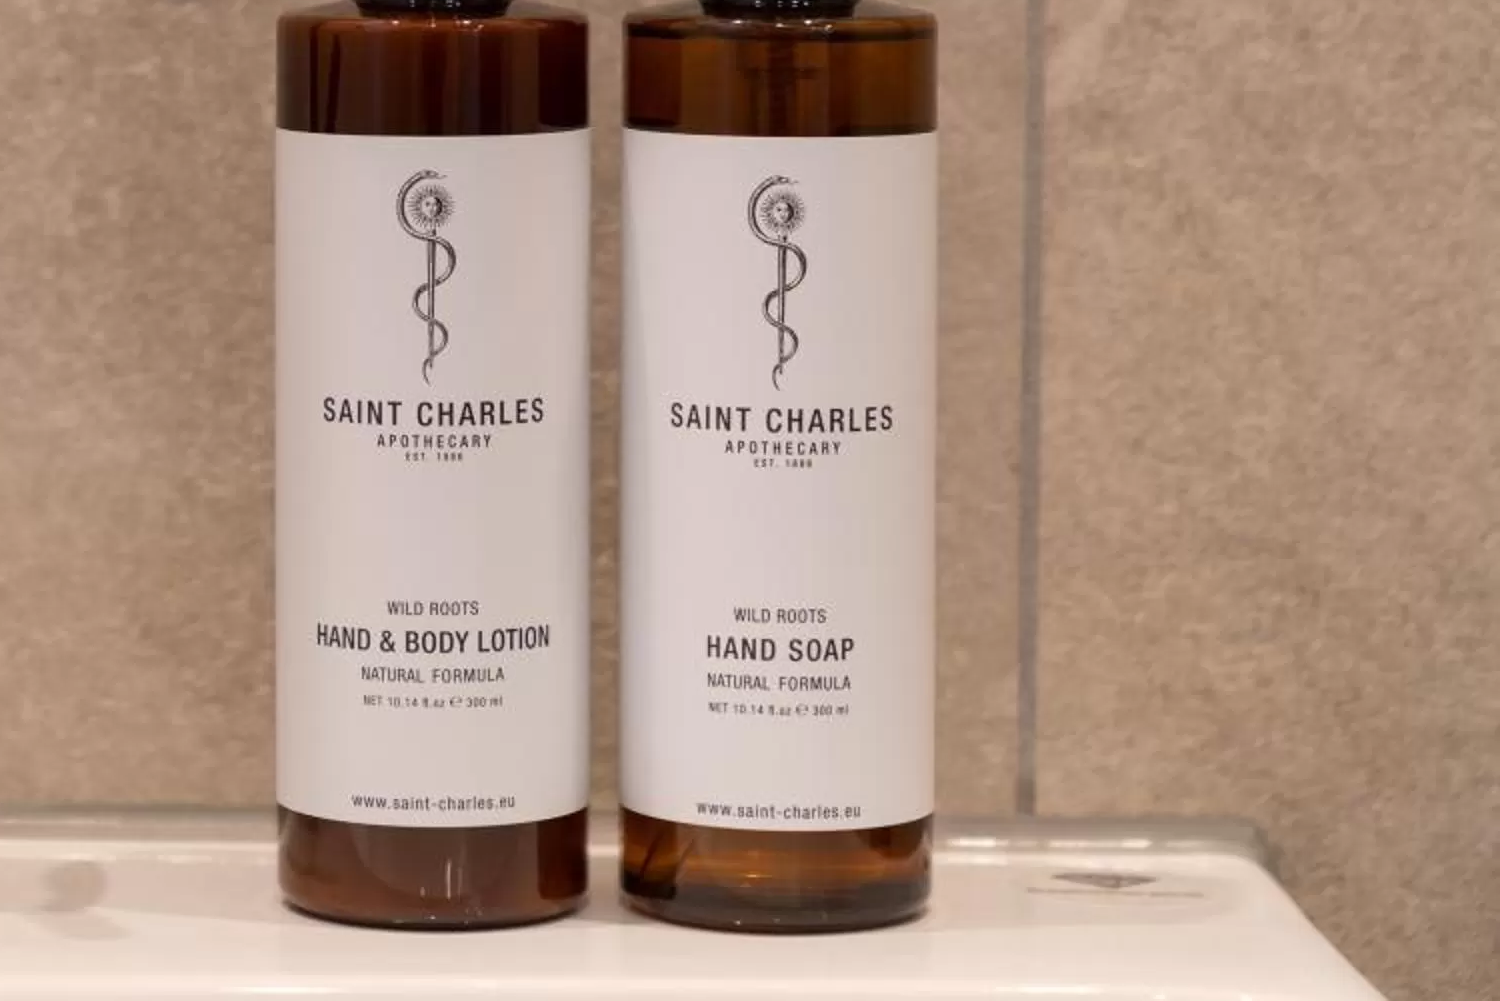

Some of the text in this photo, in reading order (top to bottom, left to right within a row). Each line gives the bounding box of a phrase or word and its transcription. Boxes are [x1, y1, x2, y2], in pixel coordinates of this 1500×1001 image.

[322, 396, 545, 427] SAINT CHARLES
[670, 401, 893, 434] SAINT CHARLES
[376, 433, 493, 449] APOTHECARY
[724, 439, 842, 456] APOTHECARY
[387, 600, 480, 617] WILD ROOTS
[733, 606, 828, 624] WILD ROOTS
[316, 622, 550, 654] HAND & BODY LOTION
[706, 634, 855, 663] HAND SOAP
[360, 666, 505, 684] NATURAL FORMULA
[706, 672, 852, 692] NATURAL FORMULA
[363, 694, 382, 706] NET
[466, 696, 487, 708] 300
[489, 695, 503, 707] ml
[707, 701, 728, 713] NET
[812, 704, 833, 716] 300
[836, 703, 849, 715] ml
[350, 794, 516, 812] www.saint-charles.eu
[696, 802, 862, 820] www.saint-charles.eu
